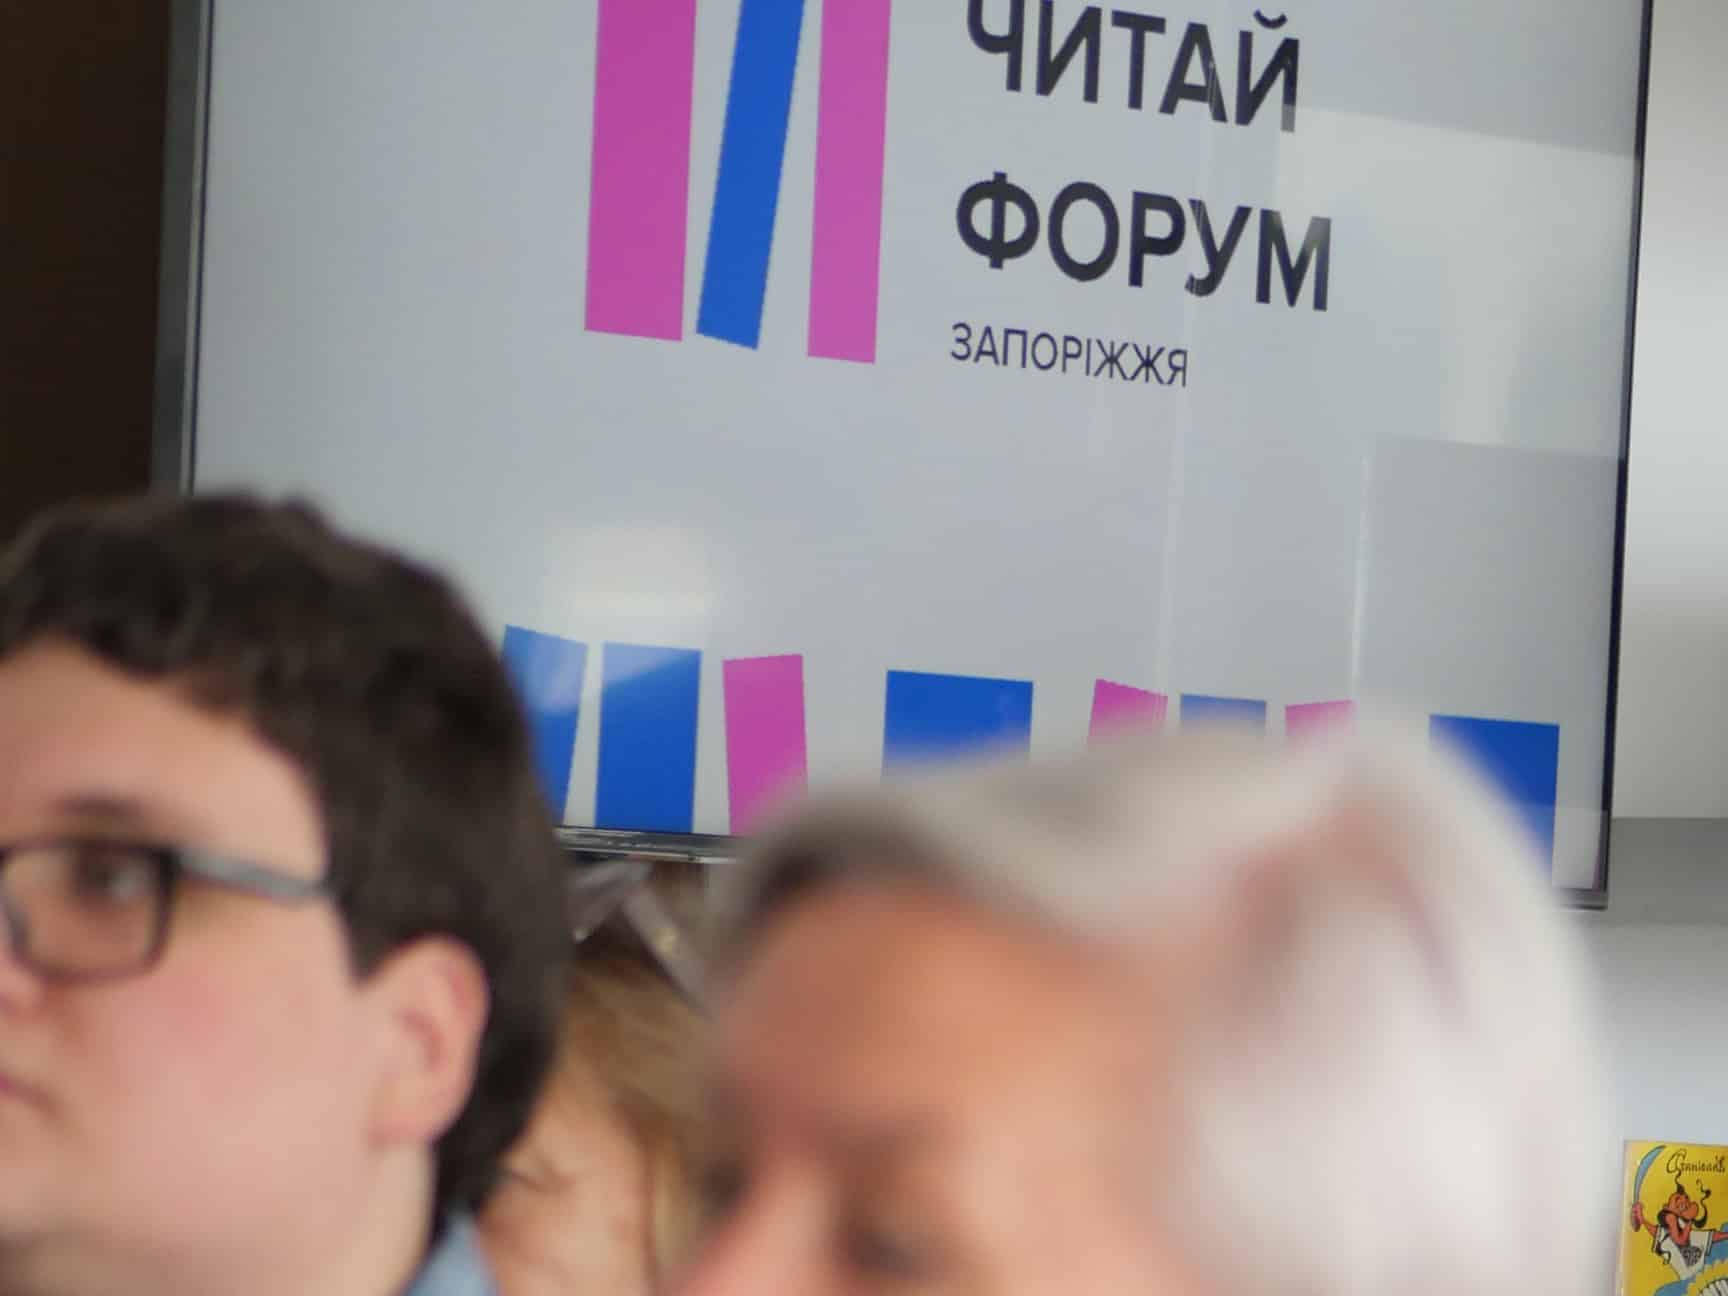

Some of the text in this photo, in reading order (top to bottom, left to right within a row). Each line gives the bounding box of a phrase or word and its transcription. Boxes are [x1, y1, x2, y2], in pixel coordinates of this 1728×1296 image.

[967, 0, 1300, 133] ЧИТАЙ
[956, 171, 1332, 312] ФОРУМ
[951, 322, 1188, 387] ЗАПОРІЖЖЯ
